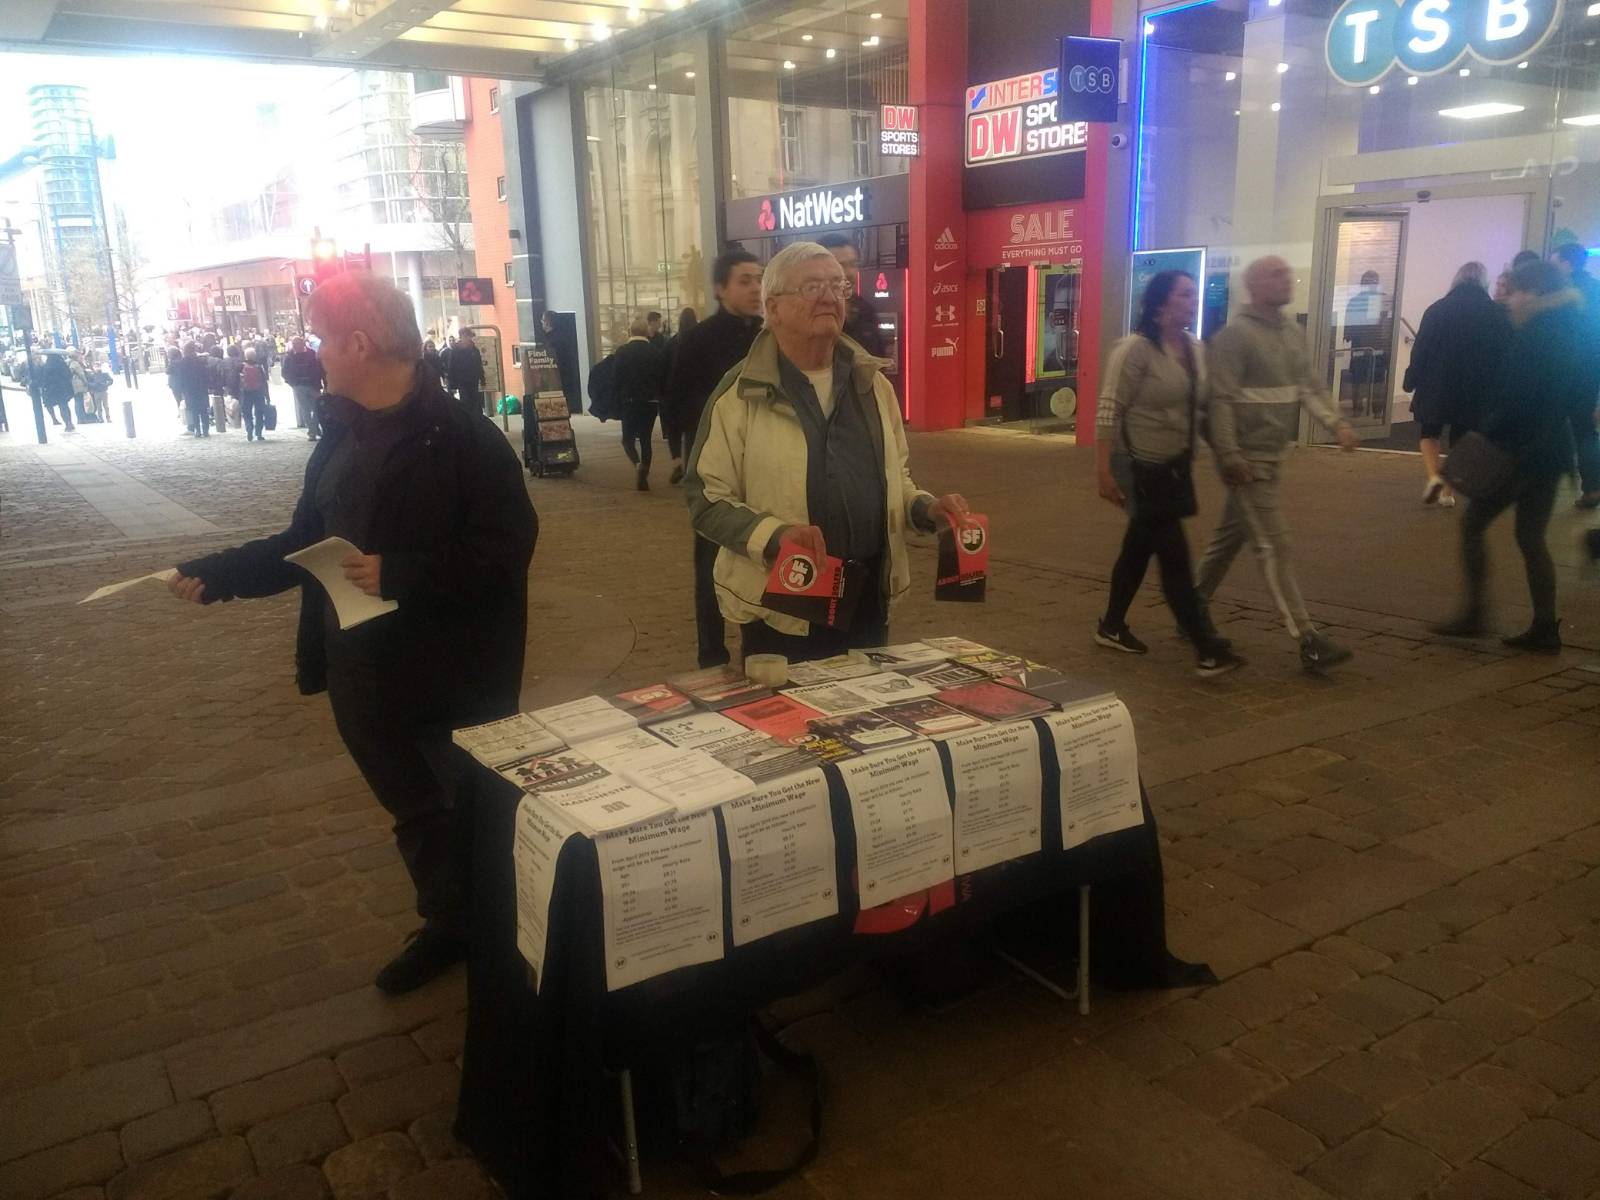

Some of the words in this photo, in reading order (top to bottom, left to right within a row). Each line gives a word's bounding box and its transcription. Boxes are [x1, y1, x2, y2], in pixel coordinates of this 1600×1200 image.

[1346, 0, 1529, 63] TSB
[989, 72, 1057, 106] INTERS
[884, 105, 915, 130] DW
[1026, 100, 1057, 127] SPO
[881, 131, 918, 143] SPORTS
[970, 110, 1020, 160] DW
[882, 143, 917, 156] STORES
[780, 187, 863, 229] NatWest
[1010, 209, 1074, 243] SALE
[1002, 248, 1046, 259] EVERYTHING
[1049, 247, 1068, 256] MUST
[1070, 245, 1082, 254] GO
[528, 350, 547, 358] Find
[529, 357, 554, 365] Family
[962, 529, 981, 545] SF
[788, 559, 809, 586] SF
[850, 765, 869, 775] Make
[869, 761, 883, 769] Sure
[884, 757, 896, 765] You
[896, 753, 907, 761] Get
[870, 764, 900, 778] Minimum
[900, 758, 919, 769] Wage
[561, 784, 632, 806] MANCHESTER
[731, 799, 751, 809] Make
[752, 794, 768, 804] Sure
[782, 786, 794, 794] Get
[805, 777, 820, 786] New
[752, 798, 786, 812] Minimum
[786, 791, 806, 802] Wage
[606, 829, 628, 840] Make
[629, 824, 648, 835] Sure
[649, 820, 663, 829] You
[664, 816, 677, 826] Get
[691, 810, 707, 820] New
[628, 830, 668, 844] Minimum
[669, 824, 690, 836] Wage
